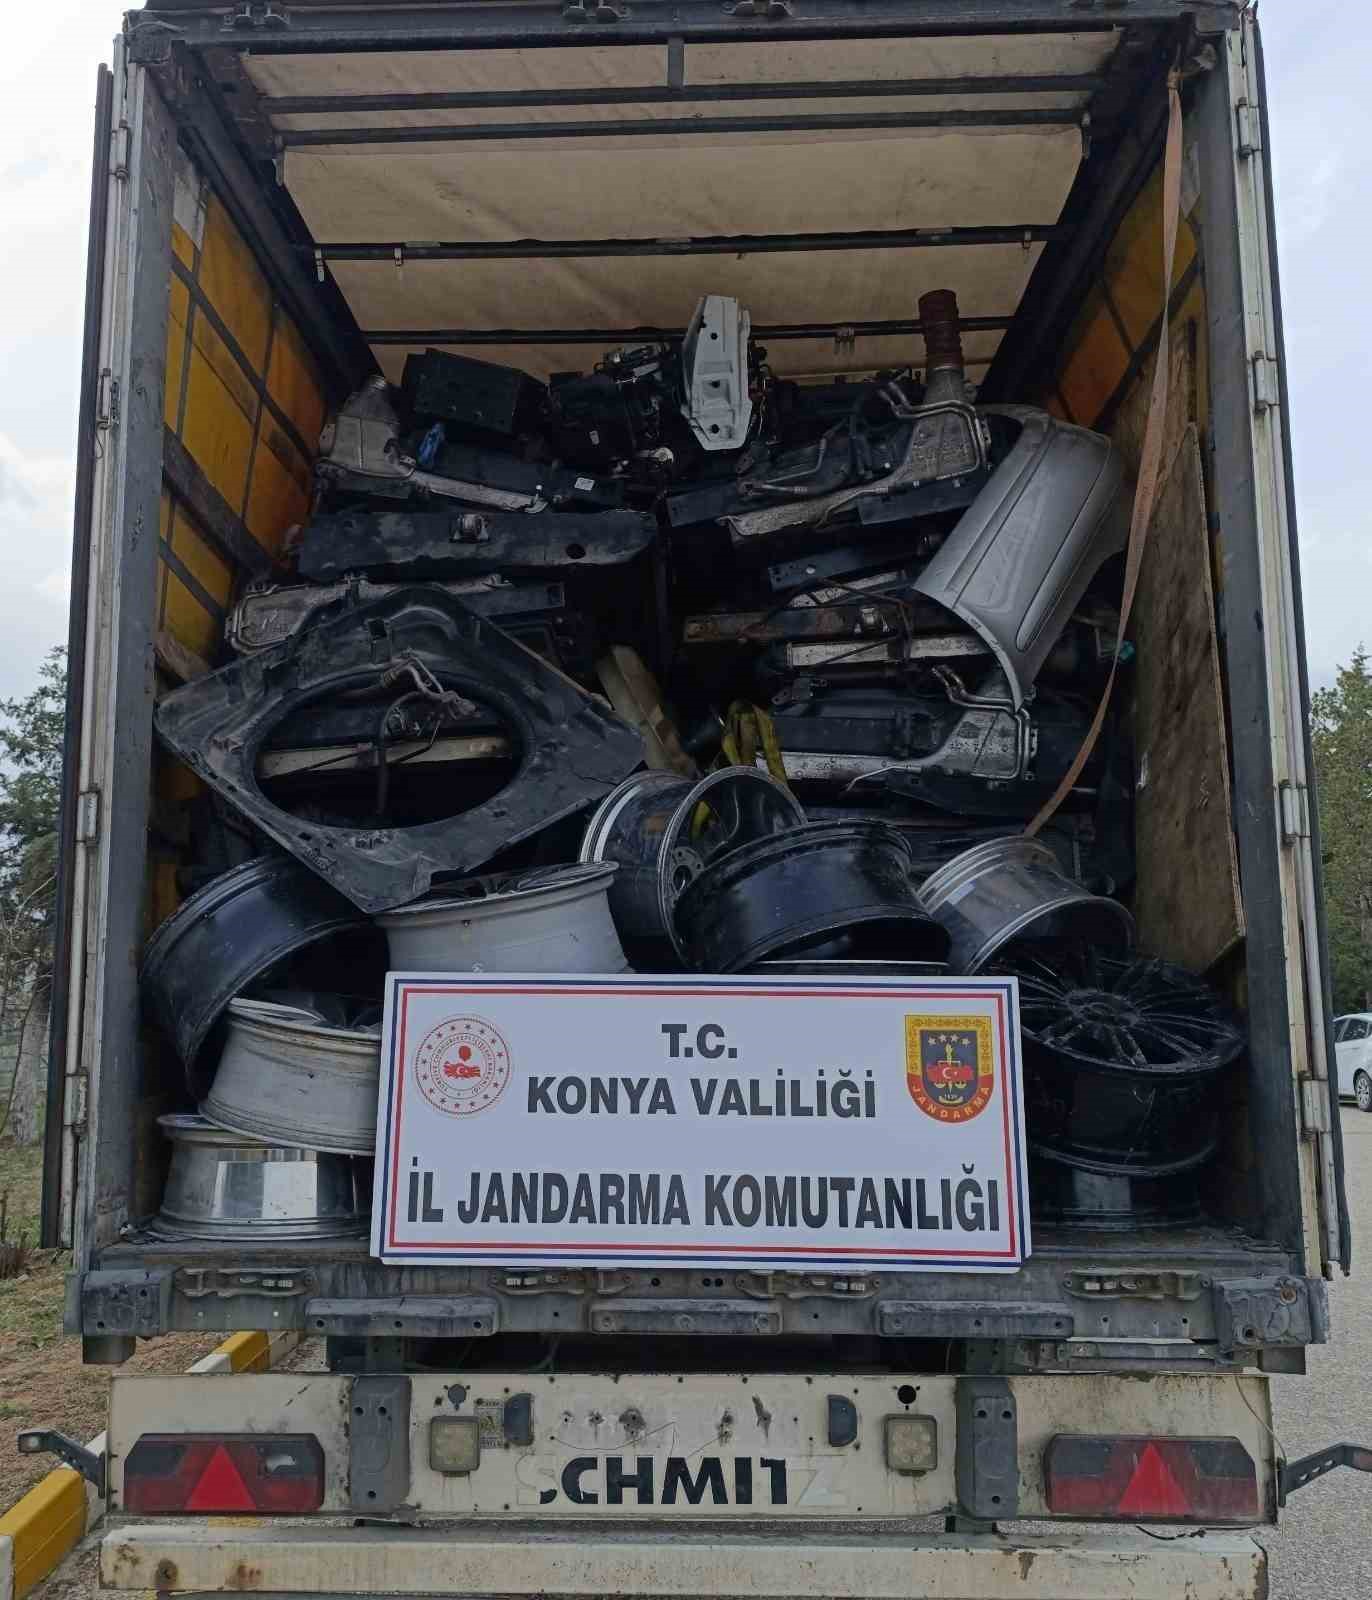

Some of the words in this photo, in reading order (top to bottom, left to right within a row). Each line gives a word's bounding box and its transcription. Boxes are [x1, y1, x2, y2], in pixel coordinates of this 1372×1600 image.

[660, 1023, 738, 1059] T.C.
[527, 1075, 677, 1115] KONYA
[689, 1068, 876, 1118] VALİLİĞİ
[912, 1085, 990, 1119] JANDARMA
[407, 1155, 444, 1223] İL
[457, 1171, 691, 1226] JANDARMA
[704, 1162, 1000, 1232] KOMUTANLIĞI
